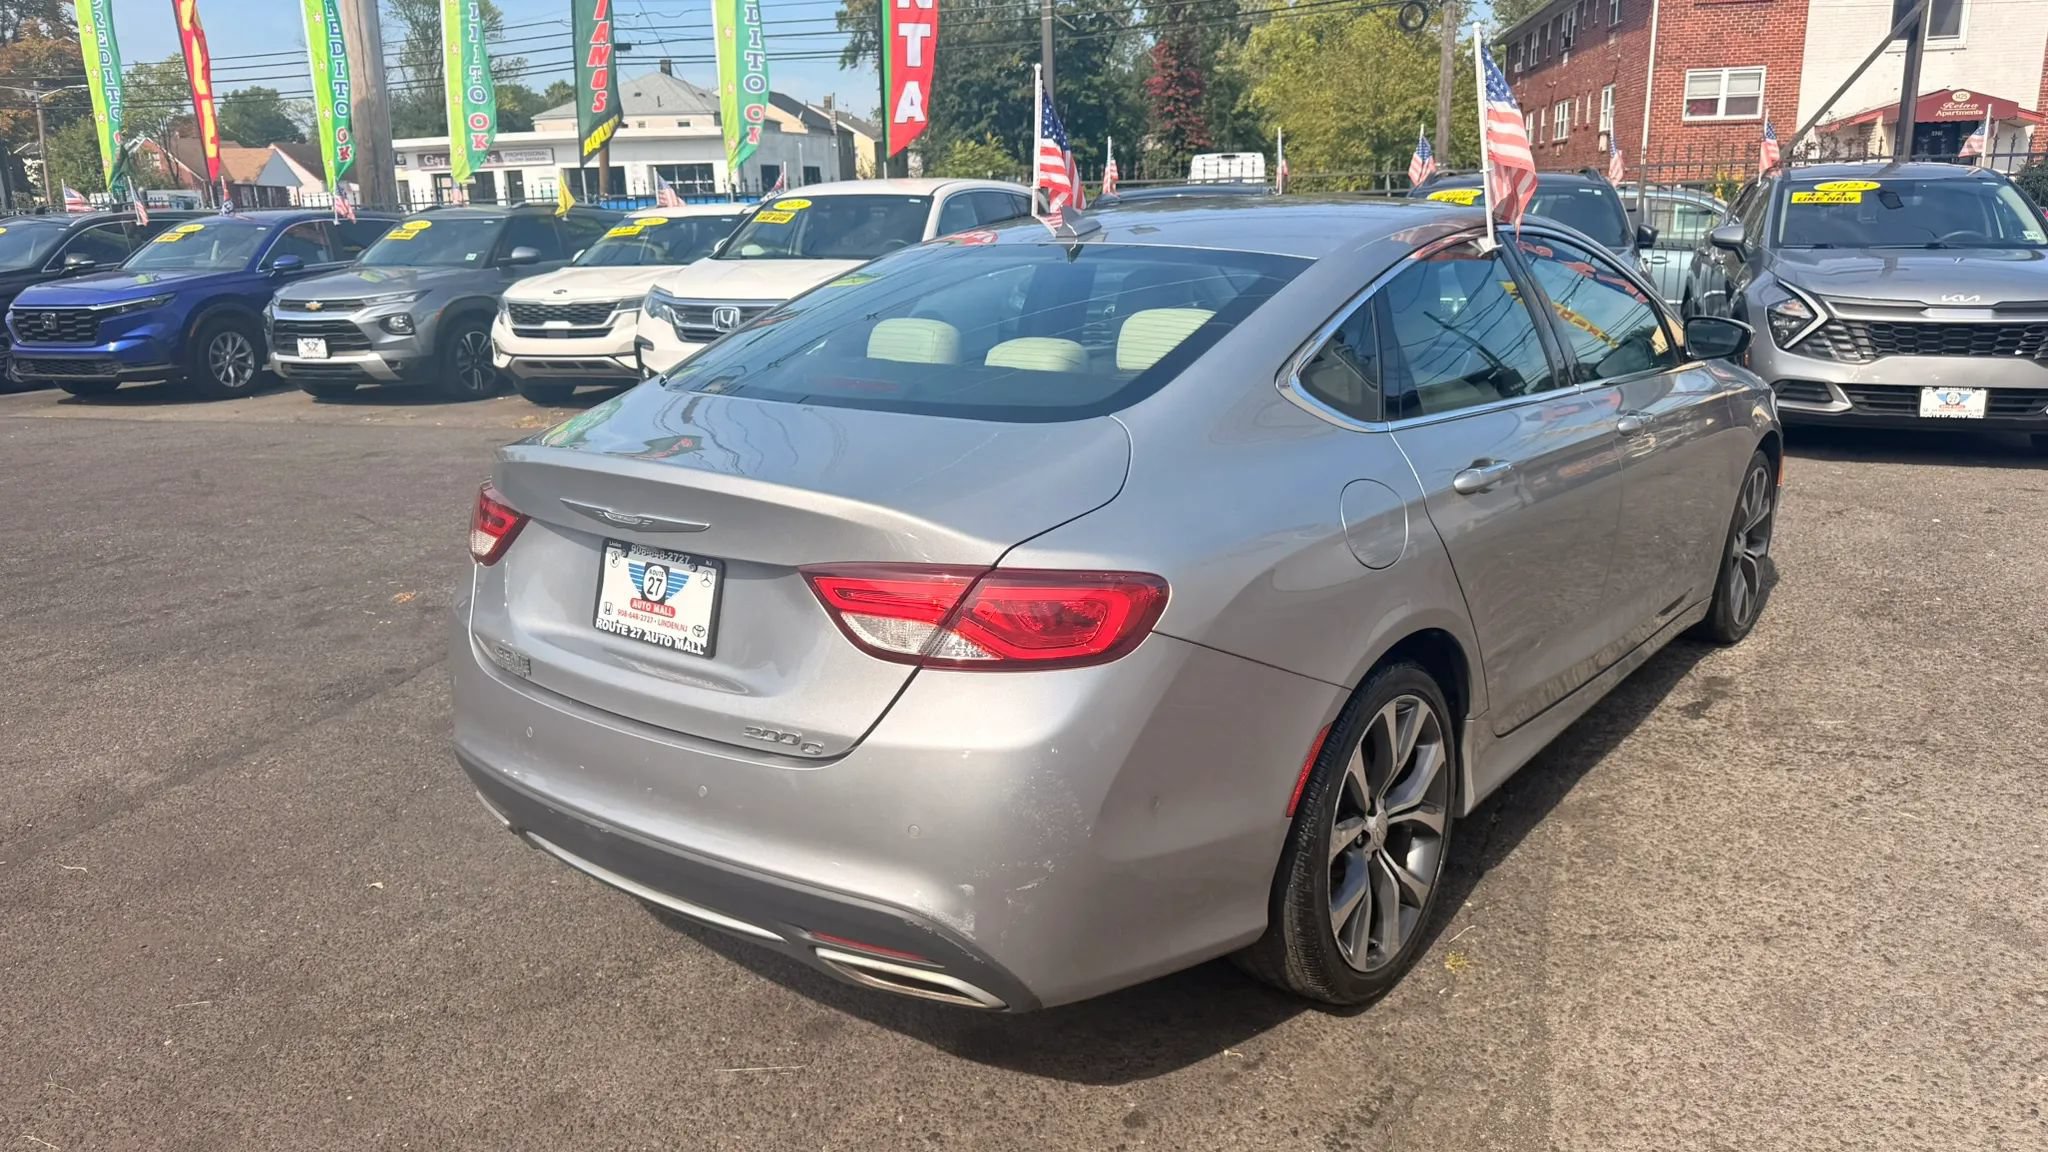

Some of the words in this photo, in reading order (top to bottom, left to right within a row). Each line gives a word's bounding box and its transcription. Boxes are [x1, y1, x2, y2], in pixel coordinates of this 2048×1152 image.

[893, 0, 933, 124] TA
[468, 112, 489, 149] OK
[744, 104, 766, 144] OK
[336, 127, 351, 163] OK
[646, 576, 663, 597] 27
[648, 568, 665, 579] ROUTE
[631, 598, 652, 612] AUTO
[653, 603, 674, 617] MALL
[595, 617, 629, 636] ROUTE
[629, 626, 642, 639] 27
[643, 629, 673, 647] AUTO
[674, 637, 705, 656] MALL
